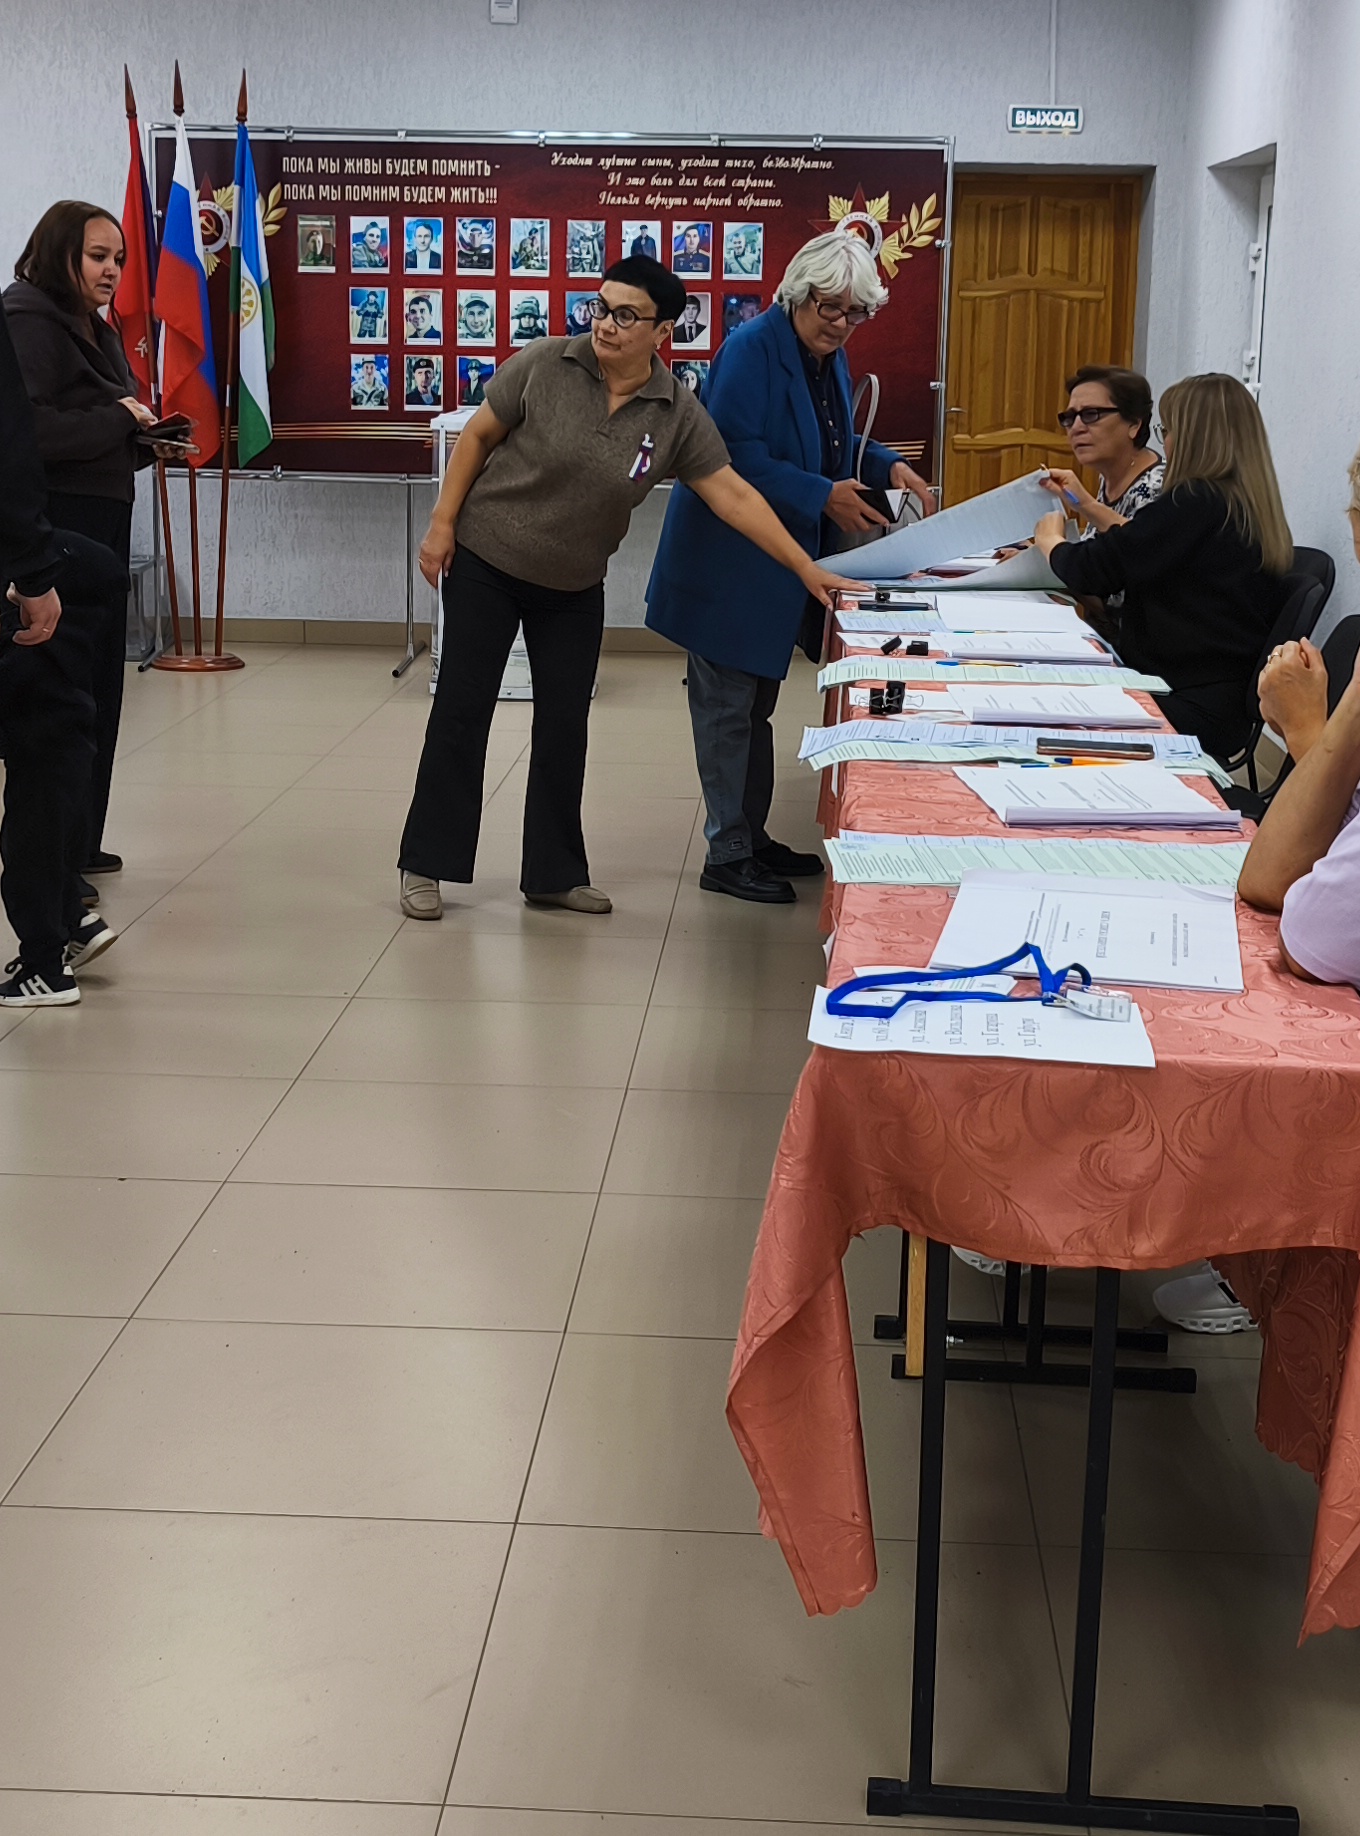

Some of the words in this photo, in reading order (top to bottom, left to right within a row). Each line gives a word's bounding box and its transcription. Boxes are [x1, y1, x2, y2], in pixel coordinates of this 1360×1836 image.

[1015, 110, 1076, 127] ВЫХОД
[282, 157, 314, 173] ПОКА
[317, 158, 340, 174] МЫ
[344, 158, 382, 175] ЖИВЫ
[386, 158, 428, 177] БУДЕМ
[432, 159, 491, 177] ПОМНИТЬ
[550, 152, 593, 166] Уходят
[597, 154, 637, 170] лучшие
[641, 158, 674, 169] сыны,
[678, 155, 720, 171] уходят
[725, 159, 756, 170] тихо,
[607, 172, 622, 186] И
[625, 176, 646, 186] это
[650, 172, 673, 186] боль
[678, 173, 698, 187] для
[703, 174, 727, 188] всей
[284, 184, 315, 201] ПОКА
[319, 184, 340, 201] МЫ
[345, 185, 400, 202] ПОМНИМ
[404, 186, 446, 204] БУДЕМ
[450, 187, 498, 204] ЖИТЬ!!!
[598, 191, 640, 206] Нельзя
[644, 191, 688, 210] вернуть
[693, 192, 733, 211] парней
